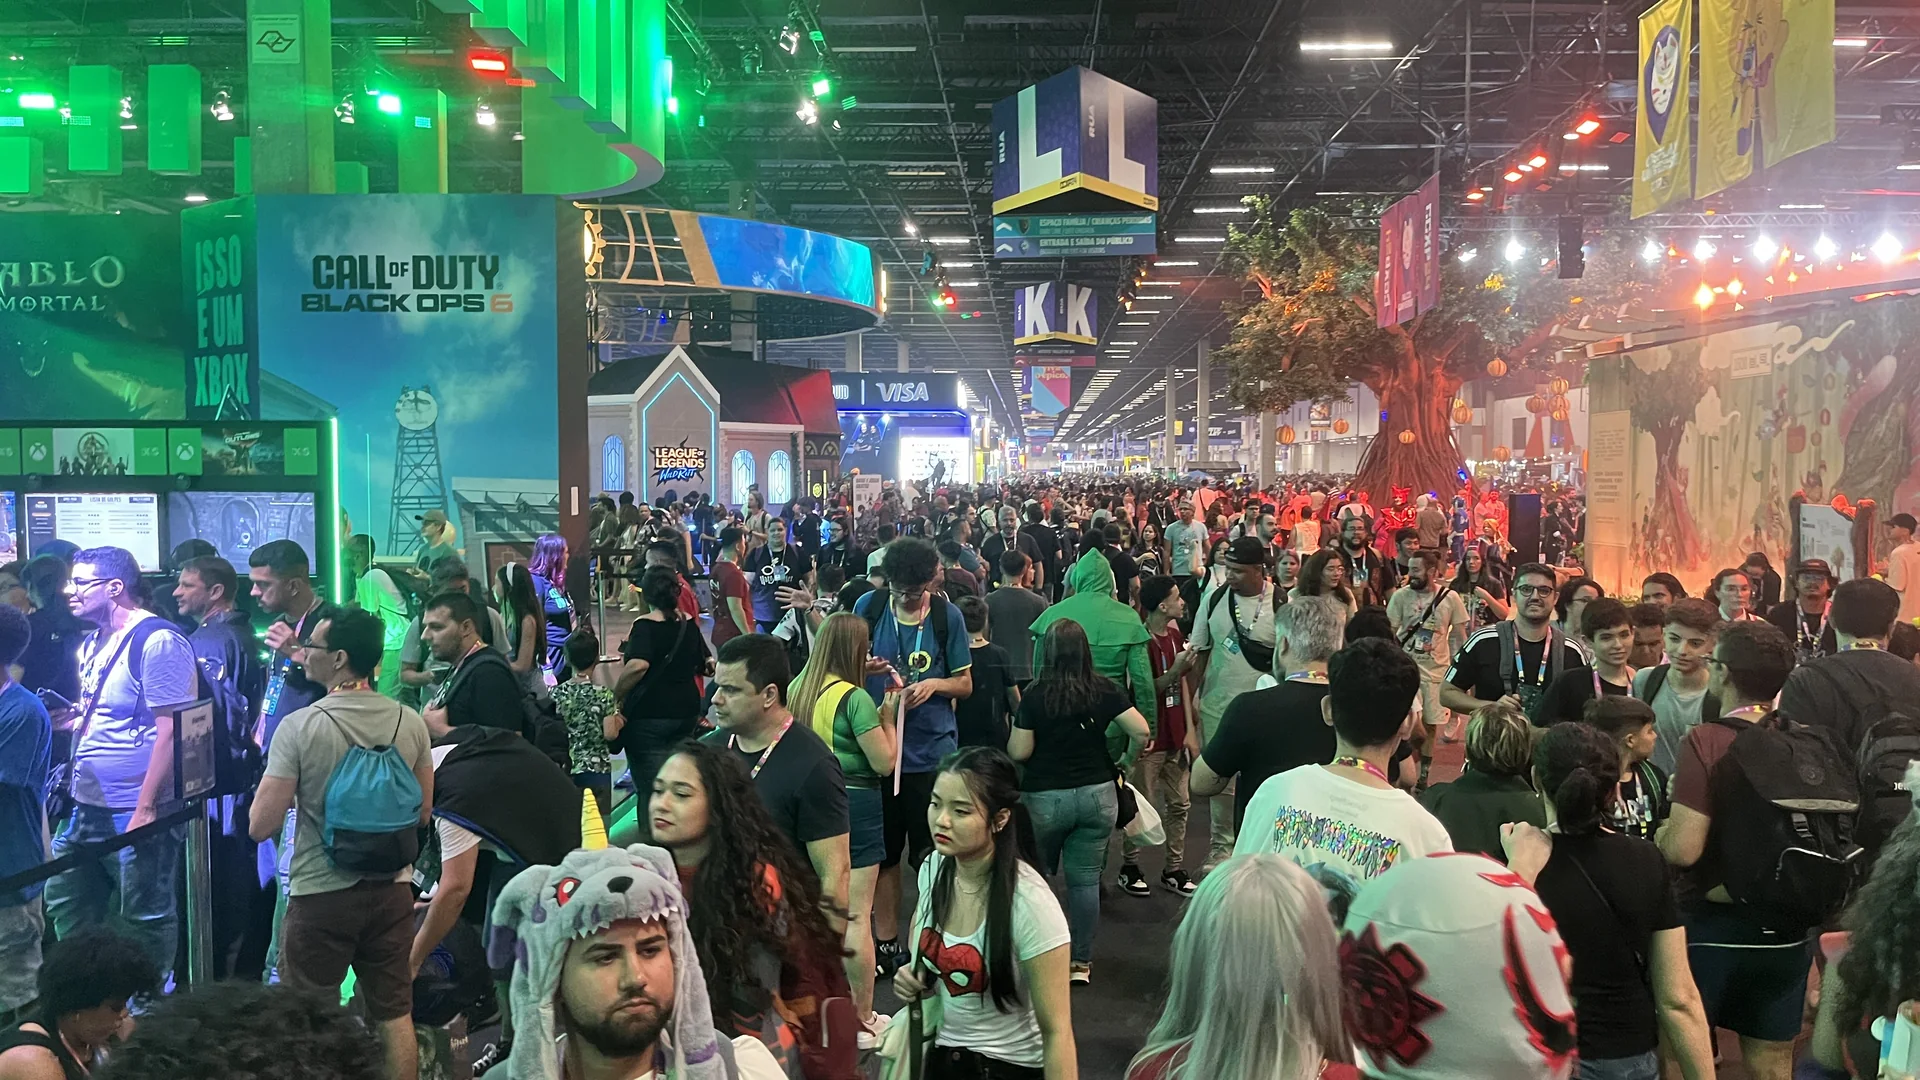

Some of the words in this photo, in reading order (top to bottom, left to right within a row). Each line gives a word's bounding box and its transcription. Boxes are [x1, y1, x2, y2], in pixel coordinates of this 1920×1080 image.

[1018, 84, 1062, 193] L
[1088, 104, 1096, 138] RUA
[1108, 79, 1146, 194] L
[998, 130, 1006, 164] RUA
[1040, 238, 1069, 247] ENTRADA
[1070, 238, 1075, 246] E
[1096, 237, 1106, 245] DO
[1106, 236, 1134, 245] PÚBLICO
[196, 234, 242, 294] ISSO
[312, 255, 392, 290] CALL
[389, 262, 409, 277] OF
[412, 255, 499, 290] DUTY
[301, 293, 411, 312] BLACK
[416, 293, 485, 312] OPS
[490, 293, 513, 312] 6
[1025, 282, 1050, 337] K
[1066, 283, 1093, 338] K
[212, 294, 244, 348] UM
[194, 353, 250, 407] XBOX
[875, 382, 929, 402] VISA
[655, 447, 698, 458] LEAGUE
[655, 458, 705, 469] LEGENDS
